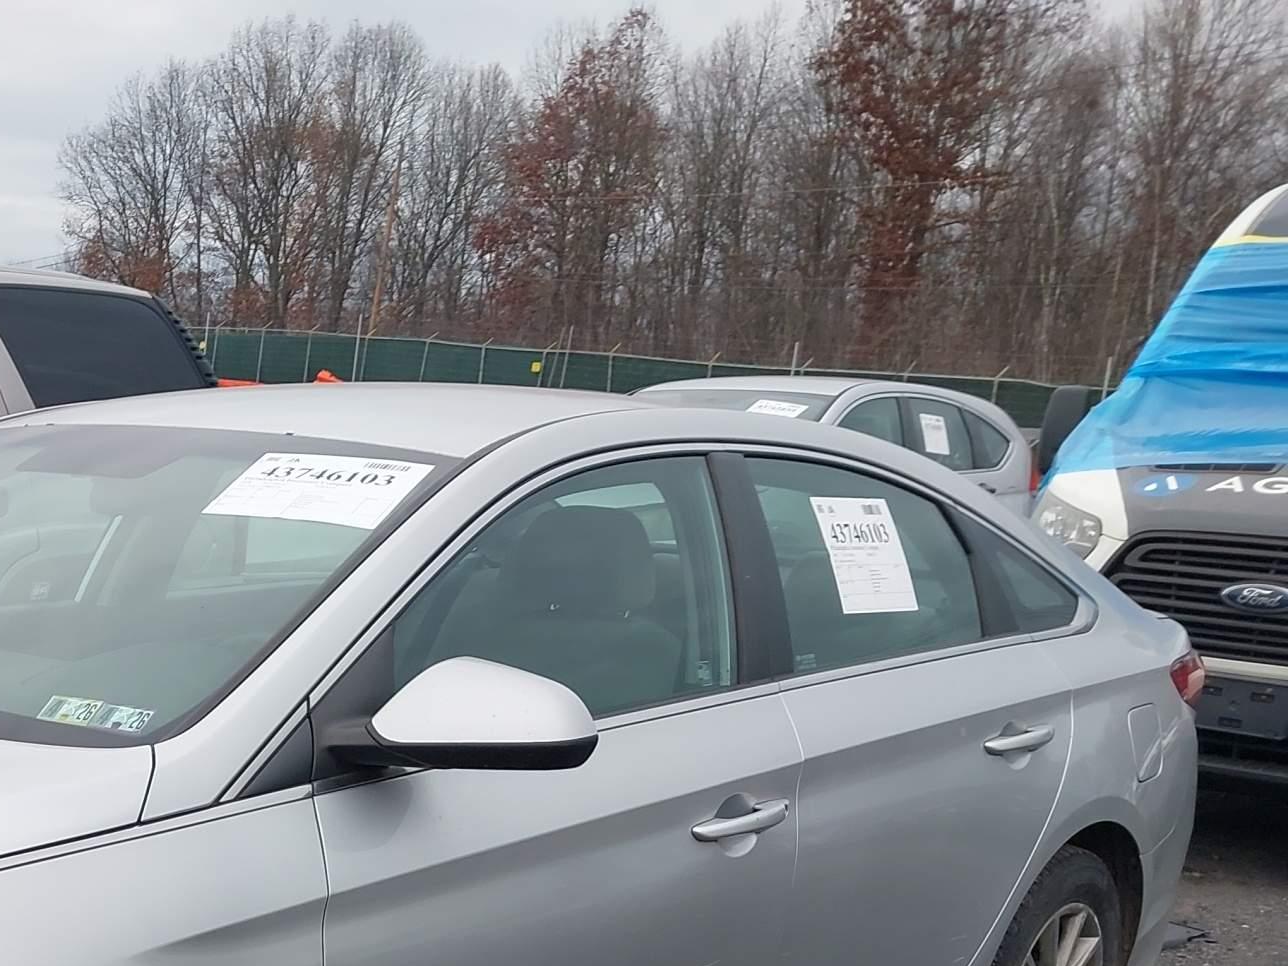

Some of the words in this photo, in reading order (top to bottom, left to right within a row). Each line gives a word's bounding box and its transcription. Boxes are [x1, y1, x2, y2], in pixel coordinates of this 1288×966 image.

[261, 465, 396, 486] 43746103
[831, 523, 890, 543] 43746103
[1238, 587, 1285, 608] Ford
[76, 703, 98, 721] 26
[128, 711, 151, 730] 26
